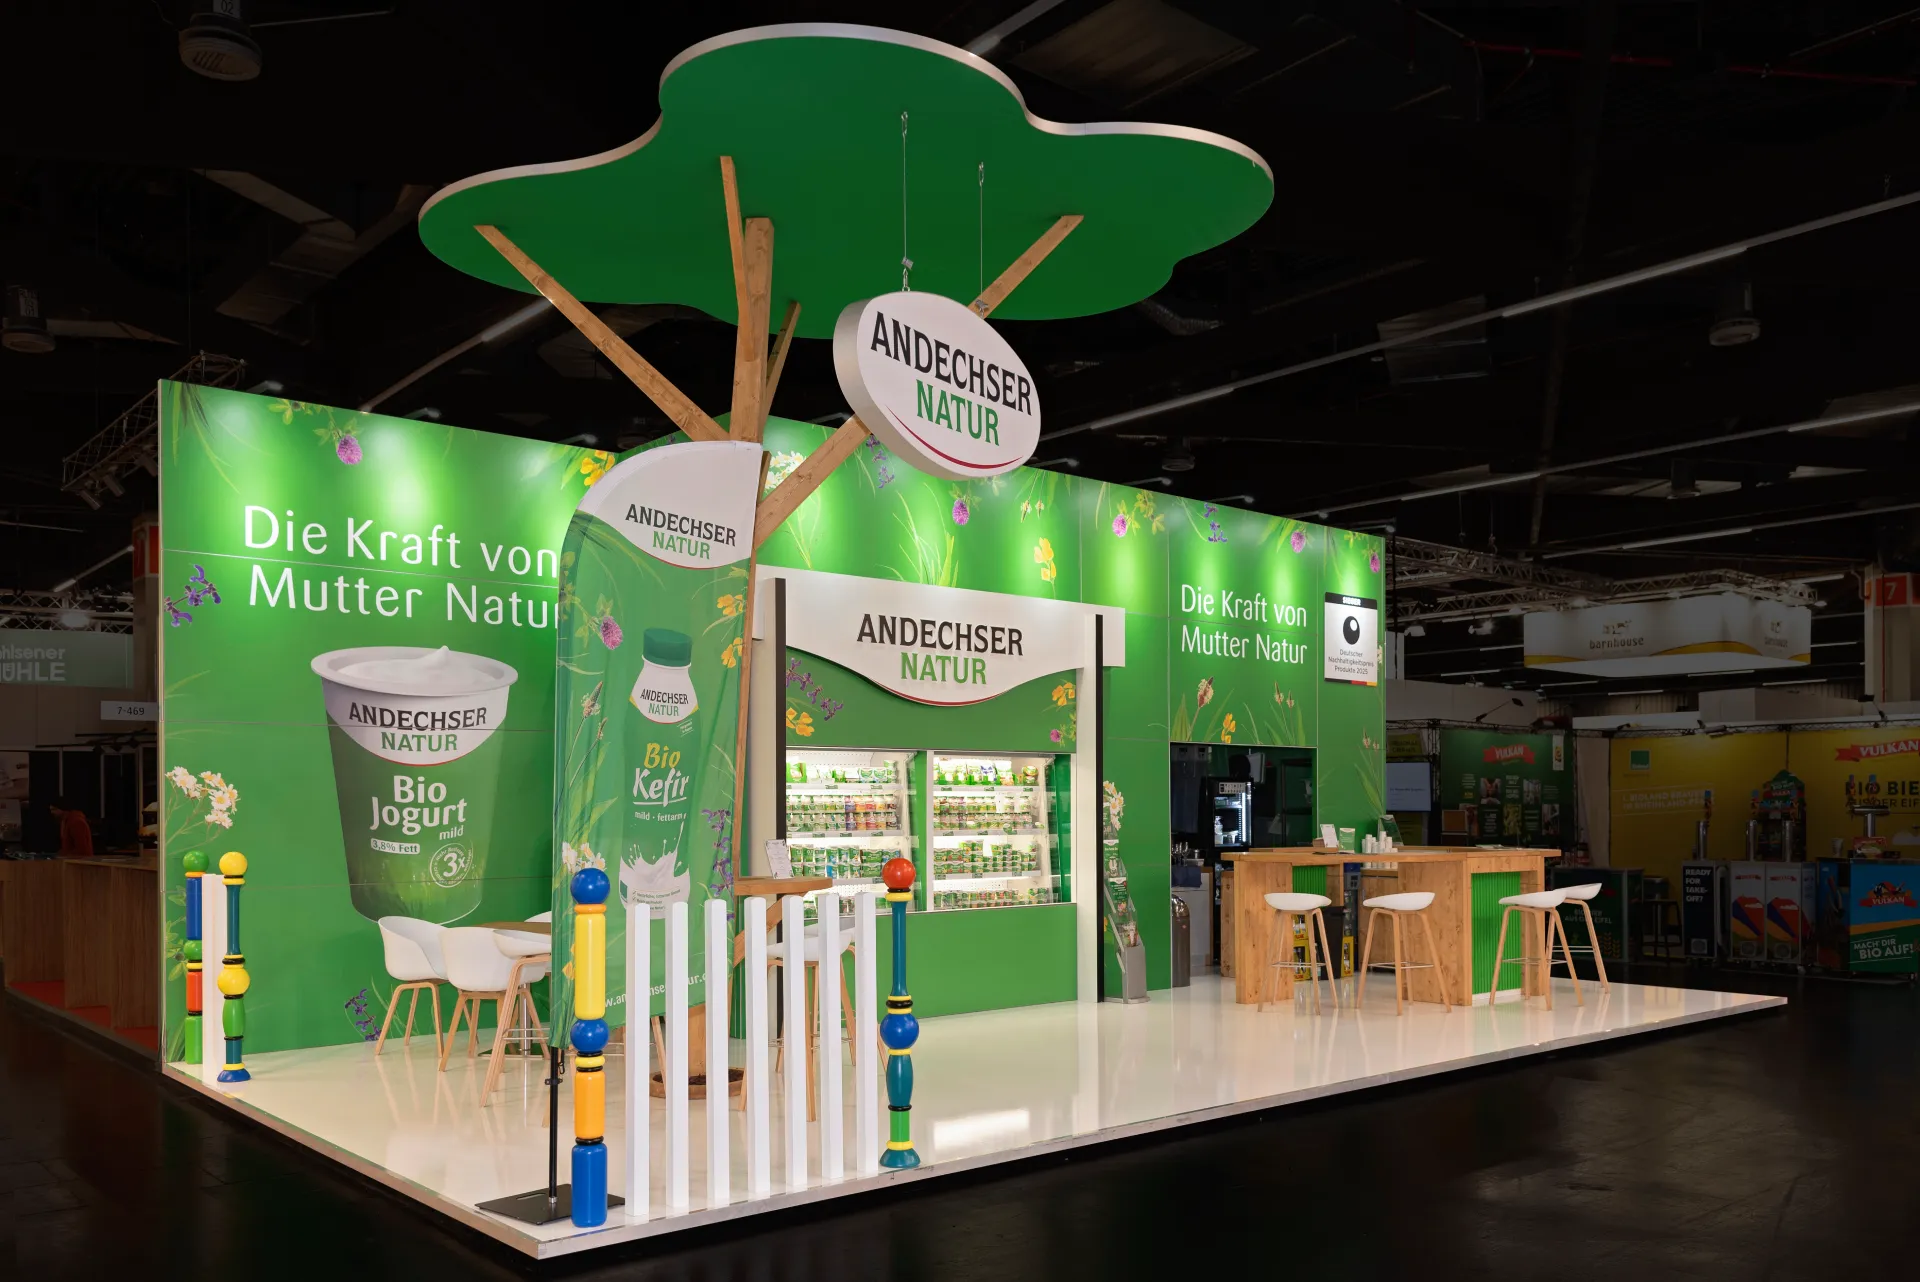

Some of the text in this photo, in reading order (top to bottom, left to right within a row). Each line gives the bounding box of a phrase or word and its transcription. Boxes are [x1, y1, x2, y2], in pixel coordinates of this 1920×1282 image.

[871, 311, 1032, 416] ANDECHSER
[916, 379, 1000, 446] NATUR
[625, 503, 737, 547] ANDECHSER
[244, 505, 558, 579] Die Kraft von
[652, 531, 711, 560] NATUR
[249, 564, 423, 619] Mutter
[1885, 584, 1897, 600] 7
[1181, 584, 1307, 628] Die Kraft von
[856, 613, 1023, 656] ANDECHSER
[1181, 624, 1308, 664] Mutter Natur
[1589, 637, 1644, 650] barnhouse
[1339, 648, 1364, 657] Deutscher
[900, 652, 987, 685] NATUR
[1334, 665, 1369, 675] Produkte 2025
[640, 688, 690, 705] ANDECHSER
[117, 701, 146, 715] 7-469
[348, 702, 488, 731] ANDECHSER
[648, 703, 680, 717] NATUR
[380, 731, 458, 752] NATUR
[1859, 738, 1920, 757] VULKAN
[643, 742, 682, 769] Bio
[393, 775, 448, 804] Bio
[632, 767, 690, 808] Kefir
[369, 797, 468, 836] Jogurt
[634, 811, 688, 823] mild fettarm
[439, 825, 464, 841] mild
[372, 839, 418, 854] 3,8% Fett
[1685, 868, 1712, 876] READY
[1685, 877, 1701, 885] FOR
[1872, 896, 1905, 905] VULKAN
[1859, 943, 1914, 960] BIO AUF!
[1881, 938, 1897, 947] DIR
